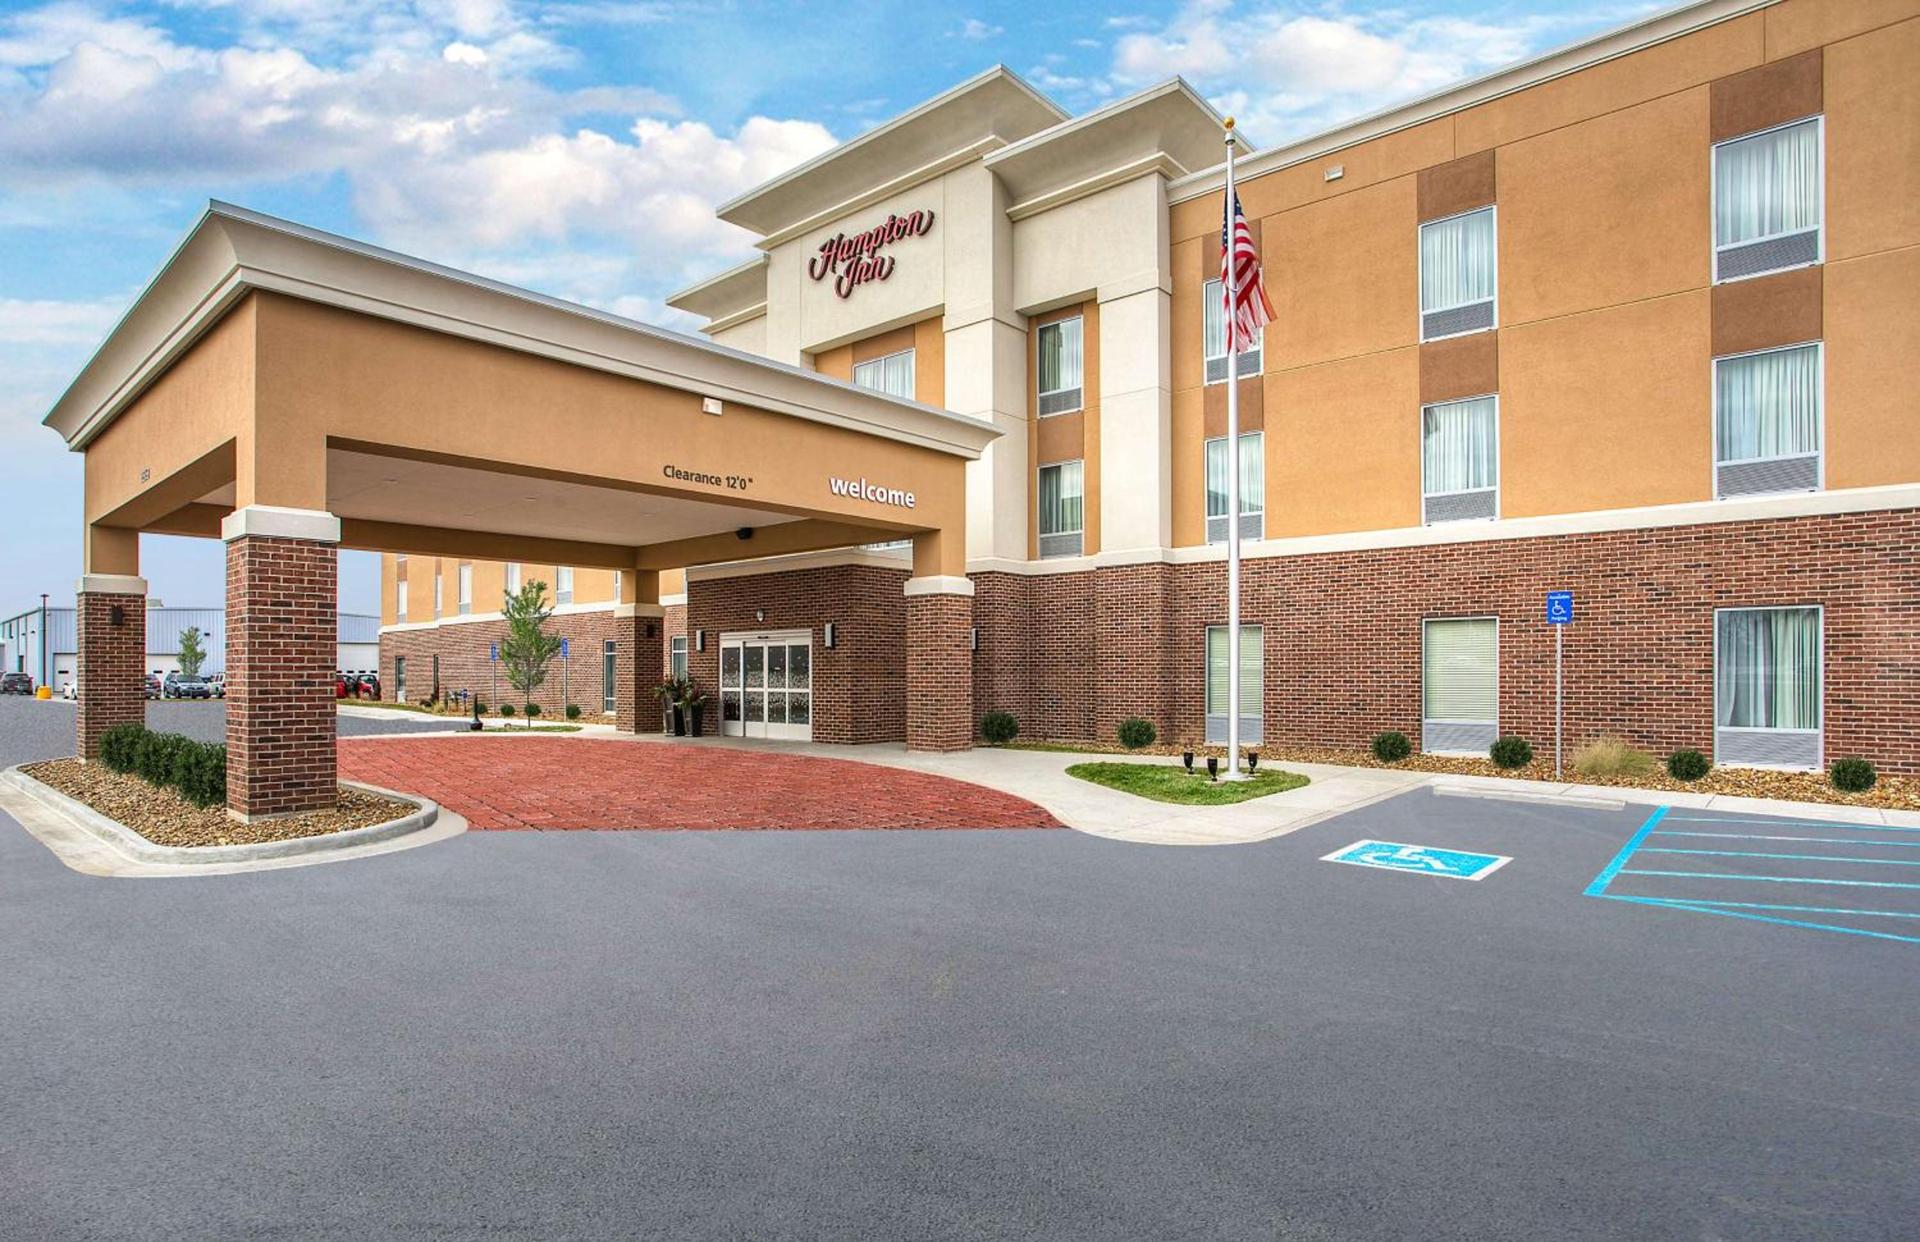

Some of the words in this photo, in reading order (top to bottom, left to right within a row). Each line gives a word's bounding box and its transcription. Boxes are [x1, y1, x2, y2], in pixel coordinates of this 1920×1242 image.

[809, 210, 935, 281] Hampton
[834, 256, 895, 299] Inn
[663, 465, 722, 487] Clearance
[829, 477, 915, 508] welcome
